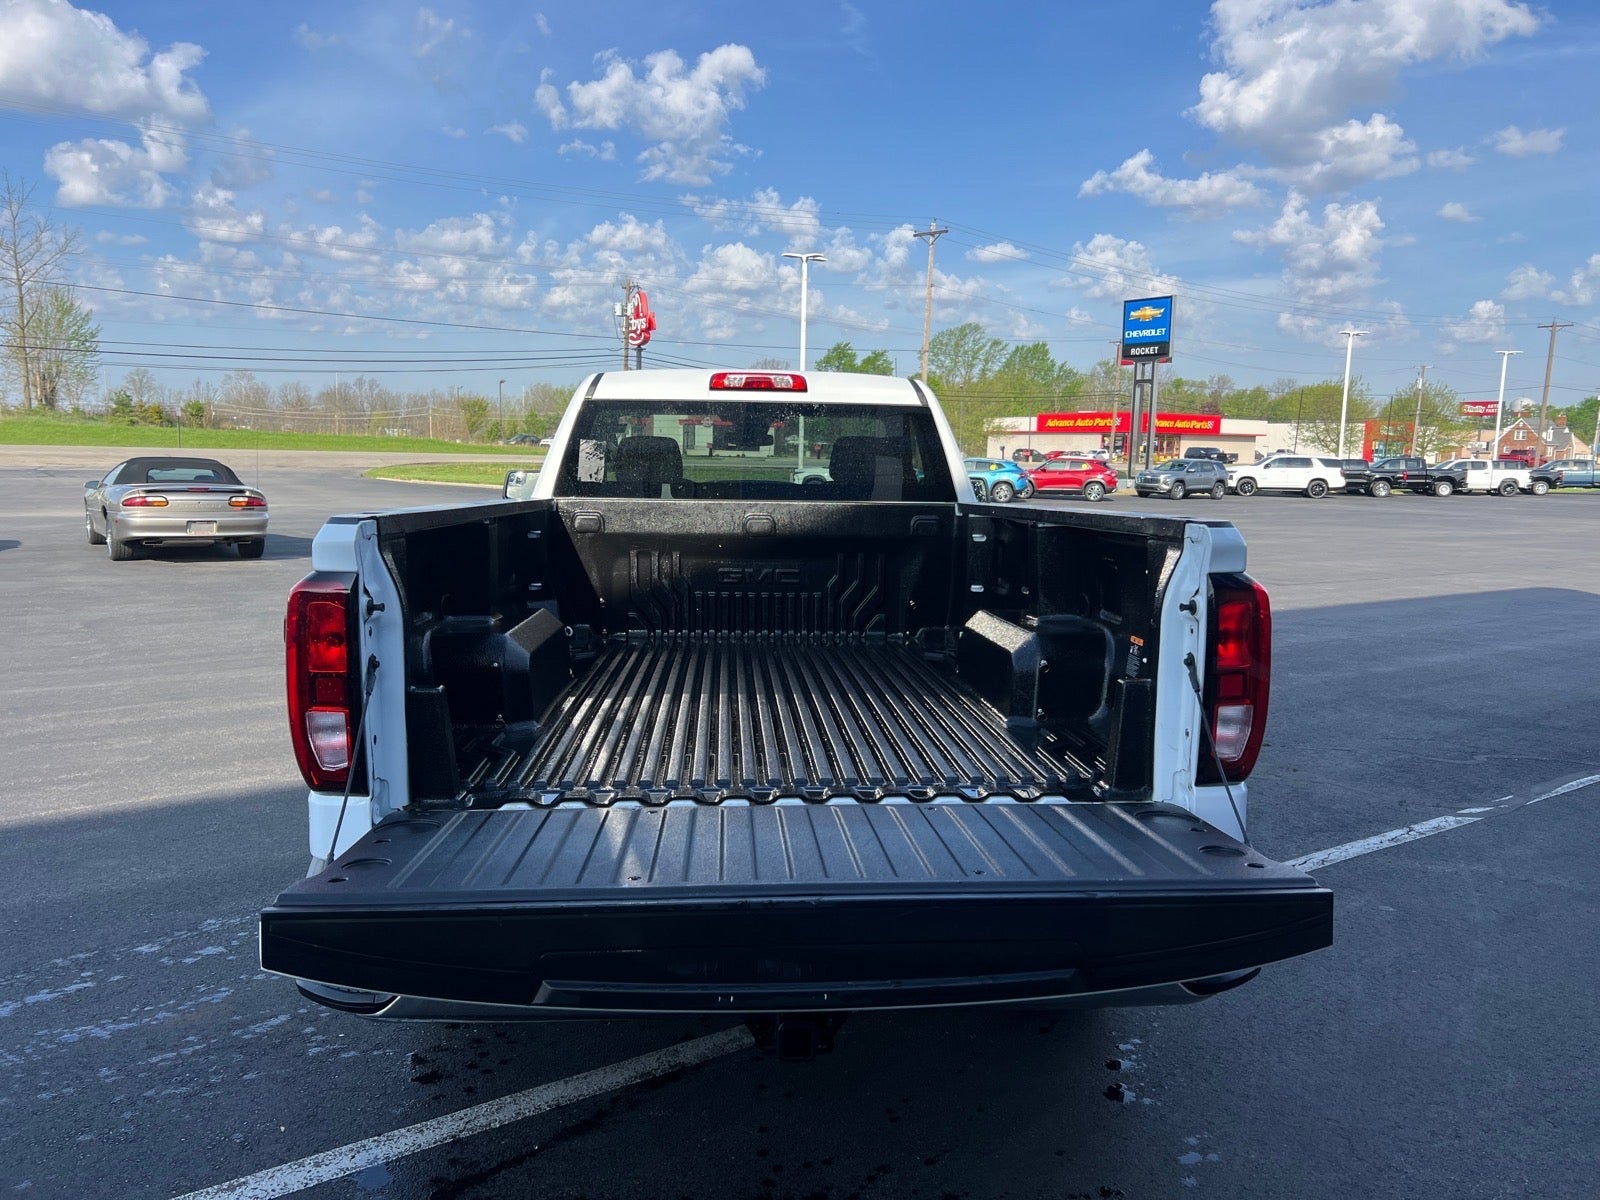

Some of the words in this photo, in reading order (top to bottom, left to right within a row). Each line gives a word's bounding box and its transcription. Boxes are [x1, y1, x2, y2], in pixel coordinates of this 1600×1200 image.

[1125, 328, 1166, 338] CHEVROLET
[1130, 346, 1159, 356] ROCKET
[1046, 418, 1074, 427] Advance
[1075, 418, 1094, 427] Auto
[1094, 417, 1114, 427] Parts
[1174, 419, 1190, 429] Auto
[1190, 420, 1209, 430] Parts
